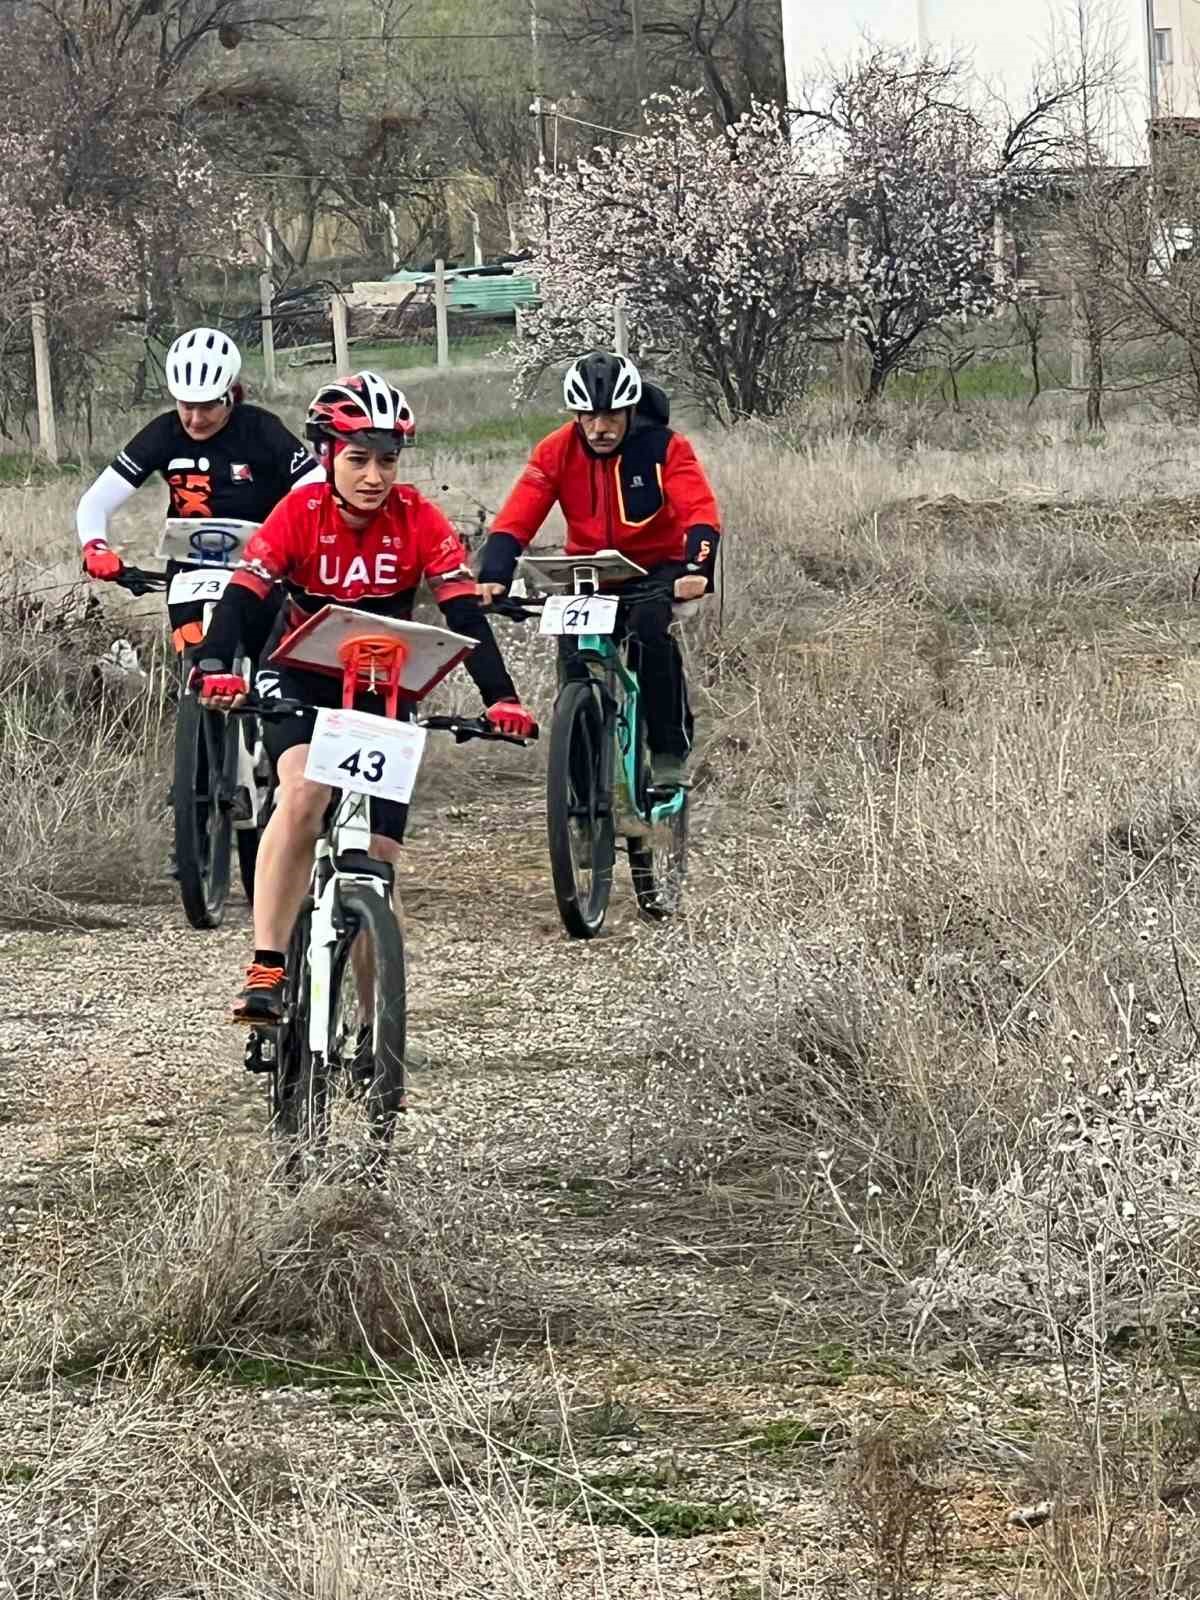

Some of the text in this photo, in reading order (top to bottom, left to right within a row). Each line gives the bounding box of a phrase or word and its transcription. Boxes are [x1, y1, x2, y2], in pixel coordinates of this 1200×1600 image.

[319, 553, 398, 588] UAE
[191, 580, 221, 594] 73
[565, 609, 590, 626] 21
[337, 748, 386, 782] 43
